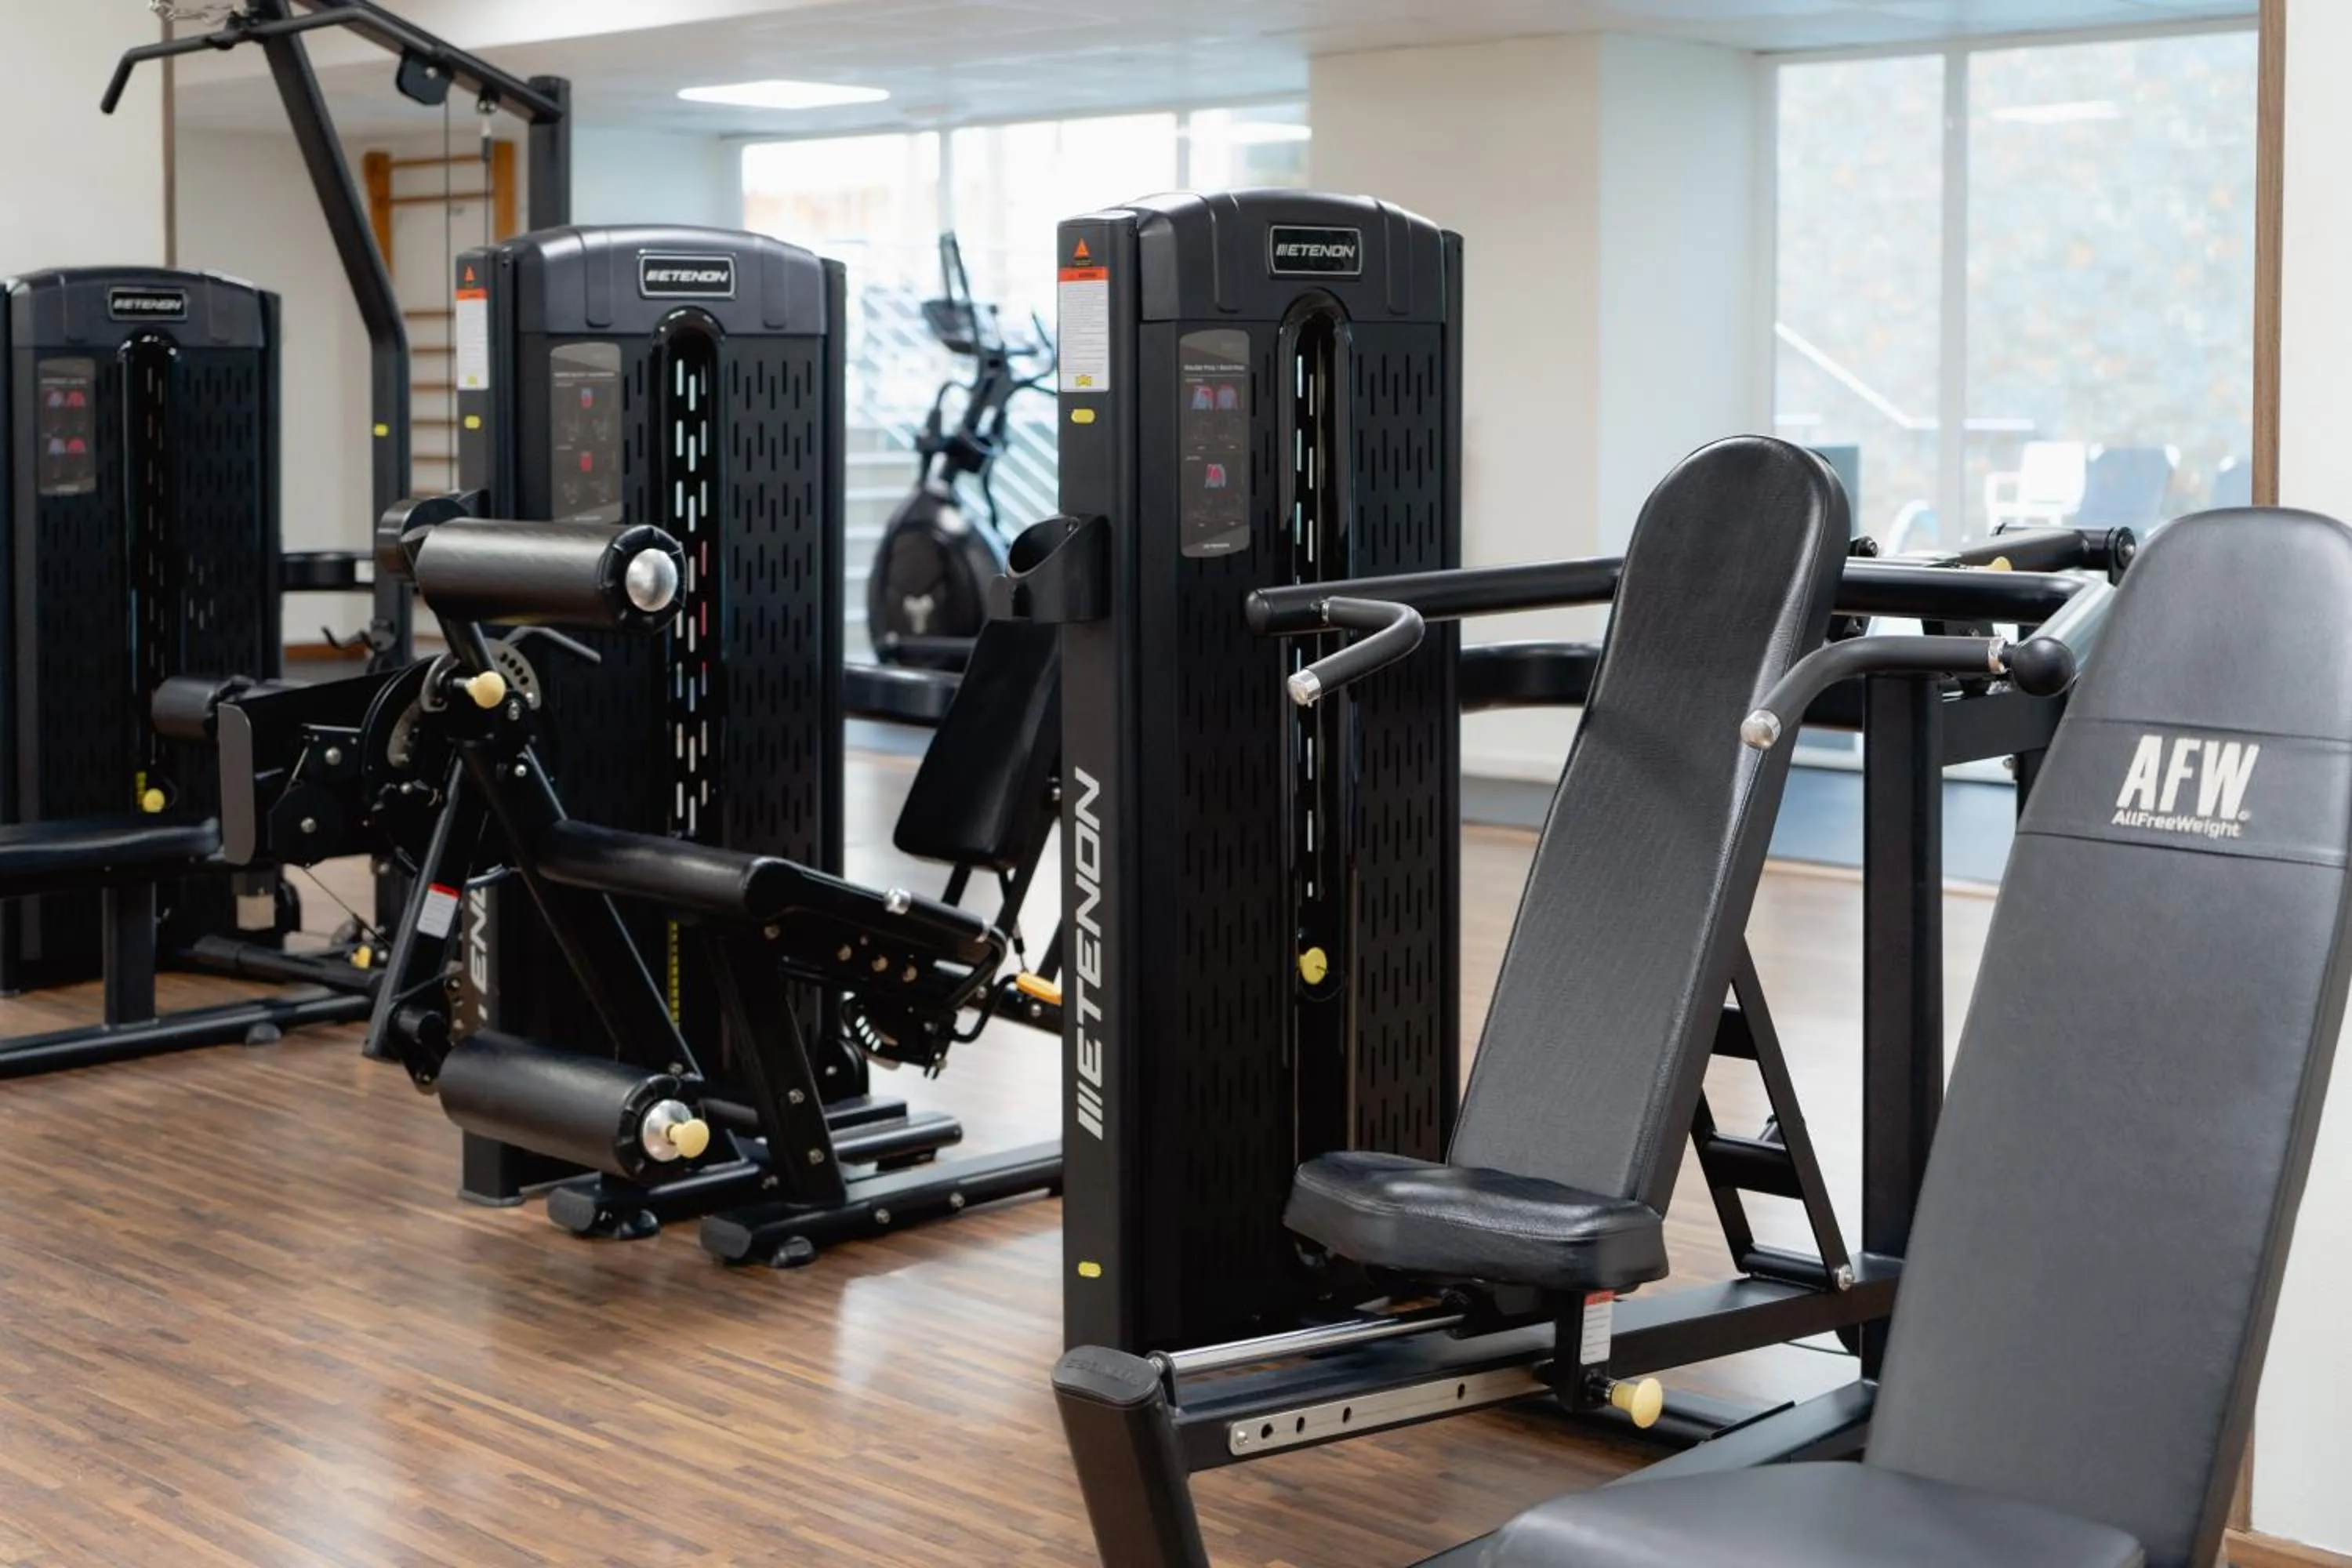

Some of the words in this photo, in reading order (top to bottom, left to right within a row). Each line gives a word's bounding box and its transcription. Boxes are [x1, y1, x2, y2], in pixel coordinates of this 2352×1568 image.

[1287, 244, 1356, 258] ETENON
[658, 270, 729, 282] ETENON
[2116, 735, 2259, 819] AFW
[2111, 810, 2243, 838] AllFreeWeight
[1075, 766, 1102, 1089] ETENON
